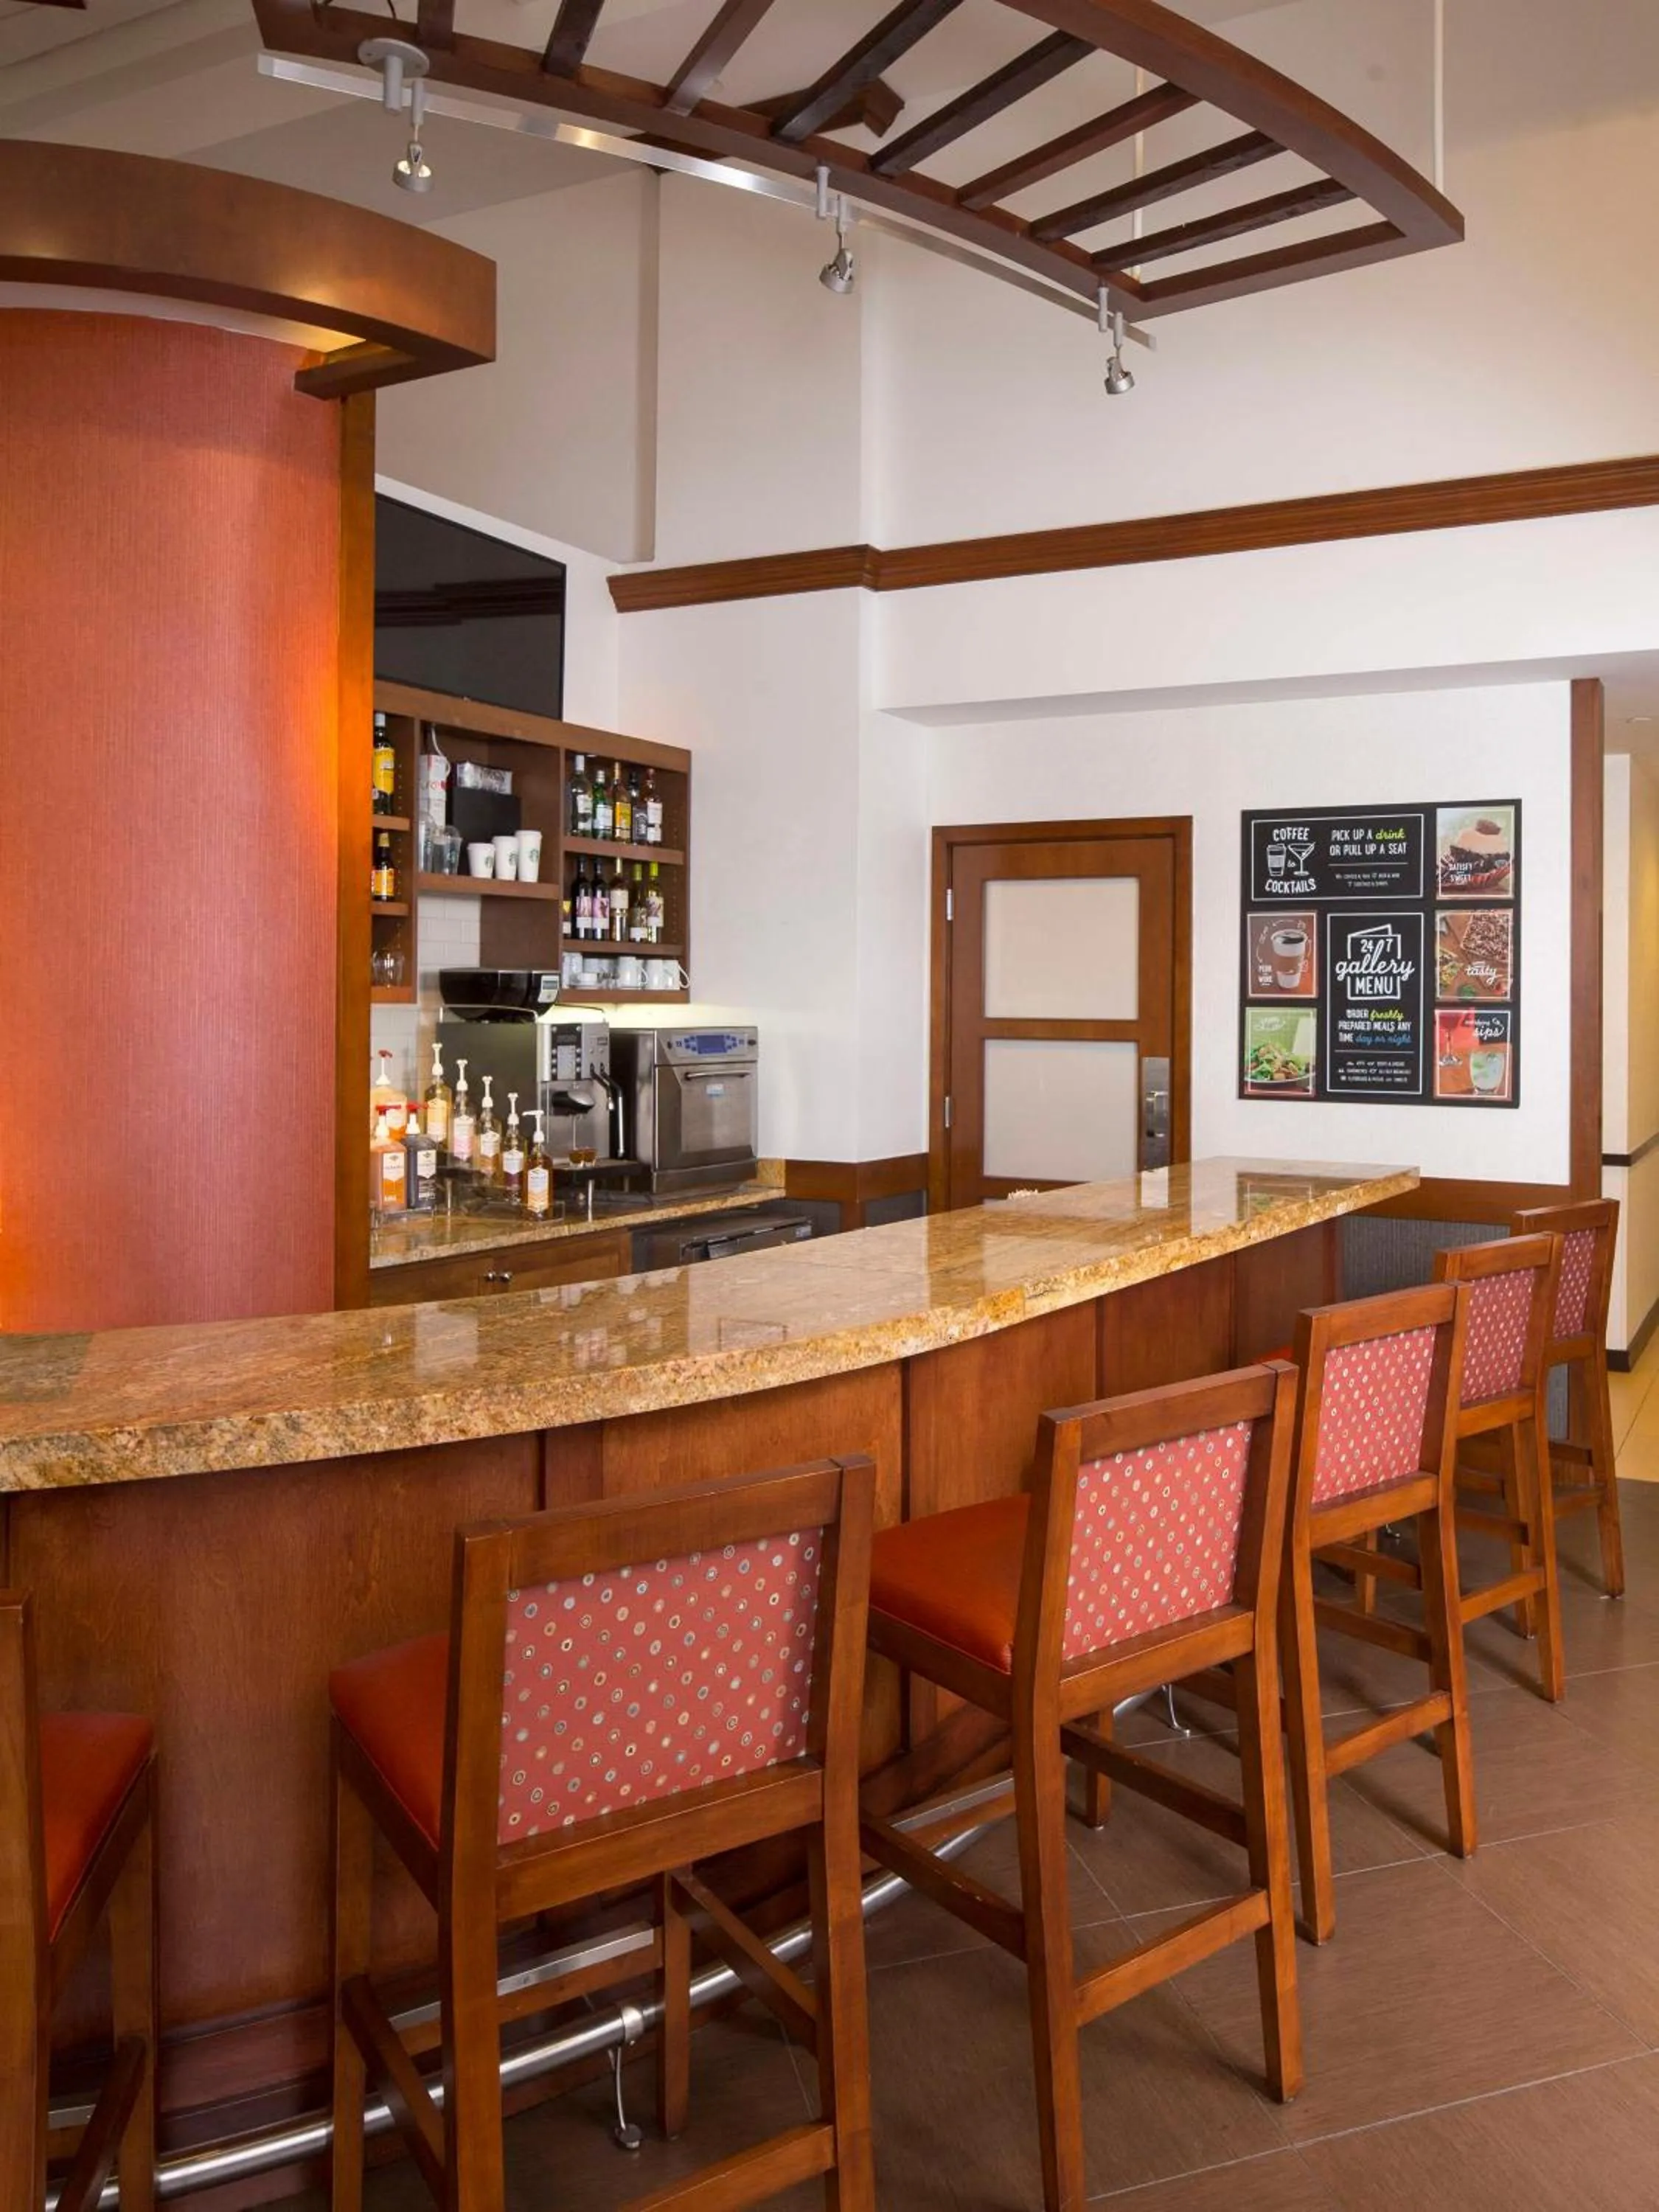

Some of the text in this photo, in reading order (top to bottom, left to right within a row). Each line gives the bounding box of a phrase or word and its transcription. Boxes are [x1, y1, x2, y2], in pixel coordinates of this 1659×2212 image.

[1273, 827, 1310, 841] COFFEE
[1331, 828, 1405, 841] PICK UP A drink
[1329, 842, 1407, 856] OR PULL UP A SEAT
[1265, 879, 1316, 894] COCKTAILS
[1335, 939, 1415, 981] gallery
[1355, 976, 1393, 995] MENU
[1346, 1009, 1368, 1018] ORDER
[1338, 1020, 1412, 1033] PREPARED MEALS ANY
[1472, 1025, 1505, 1040] sips
[1338, 1032, 1354, 1043] TIME
